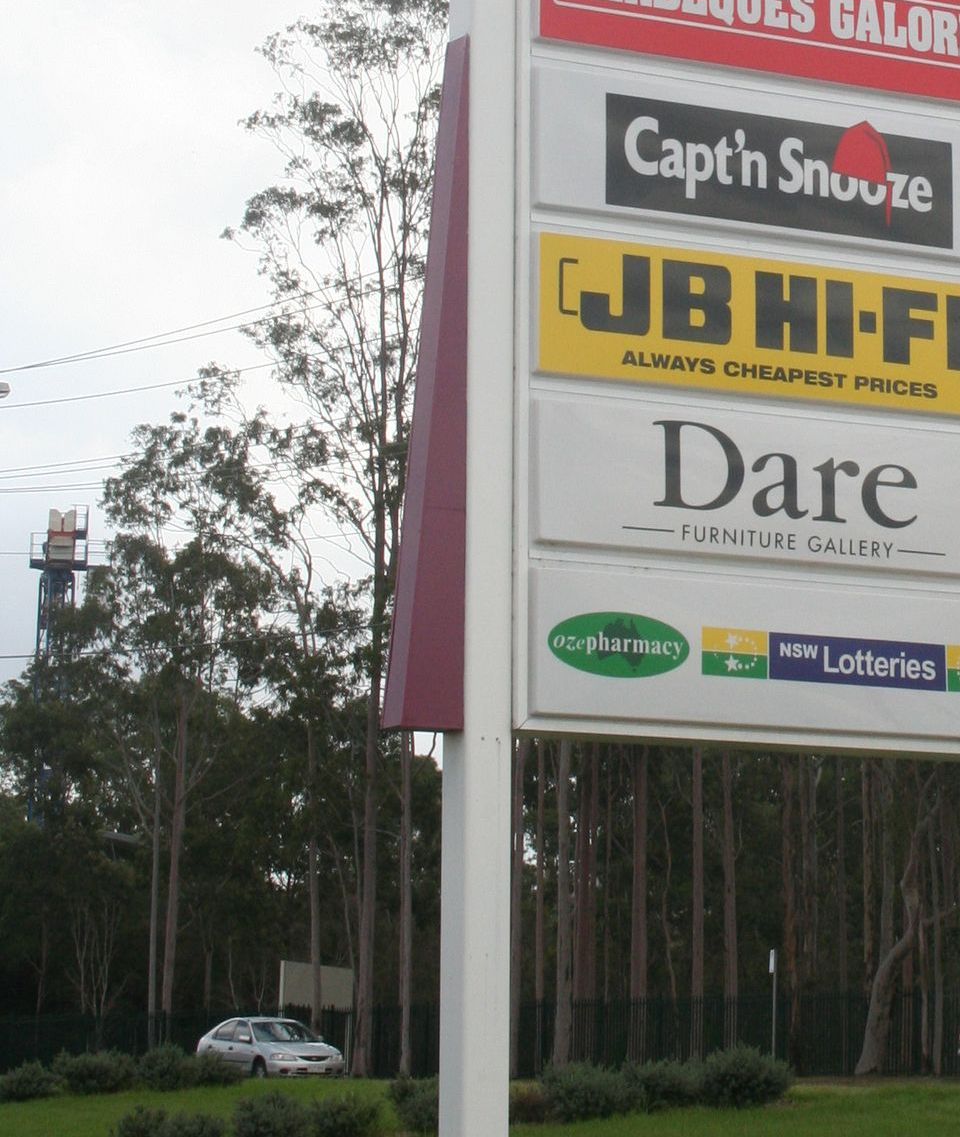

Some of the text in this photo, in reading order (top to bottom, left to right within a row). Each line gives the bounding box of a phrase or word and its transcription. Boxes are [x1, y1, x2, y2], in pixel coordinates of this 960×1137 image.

[624, 115, 933, 213] Capt'n Snooze
[580, 253, 732, 345] JB
[621, 350, 938, 399] ALWAYS CHEAPEST PRICES
[652, 420, 918, 529] Dare
[681, 524, 894, 559] FURNITURE GALLERY
[779, 642, 937, 681] NSW Lotteries
